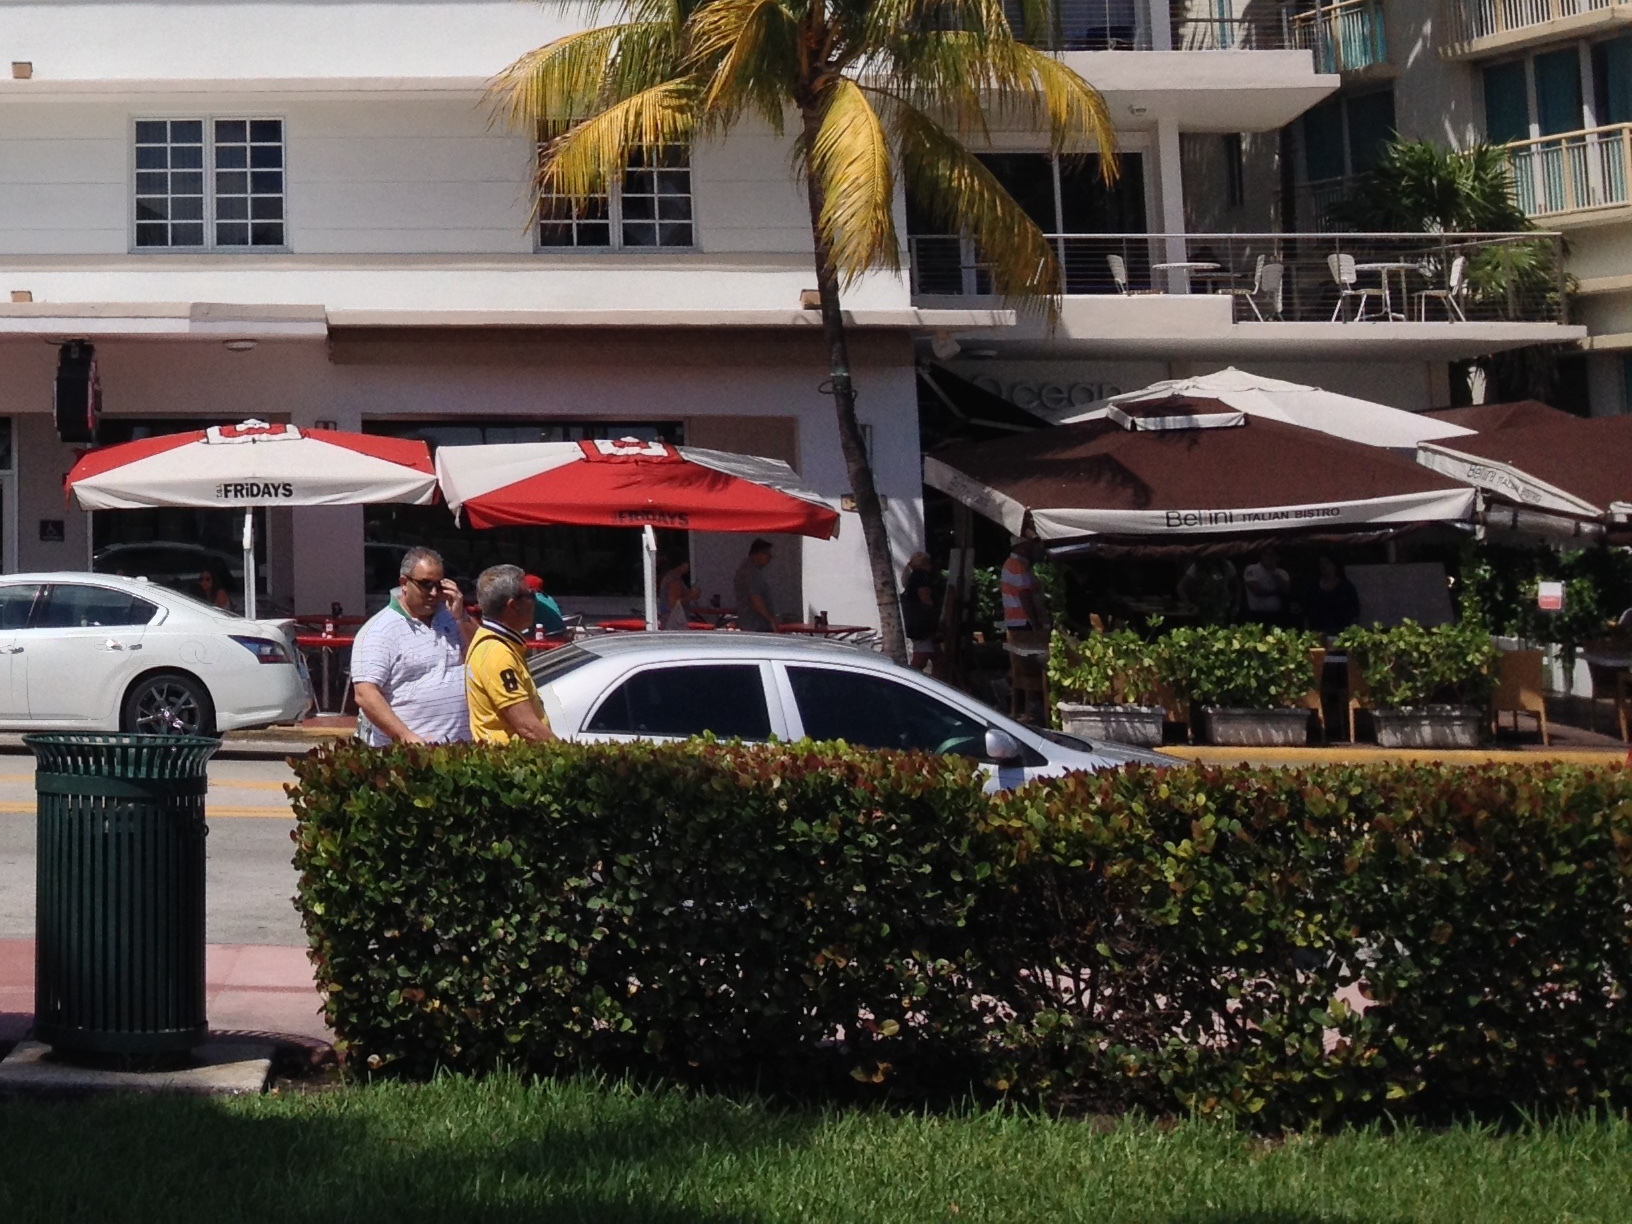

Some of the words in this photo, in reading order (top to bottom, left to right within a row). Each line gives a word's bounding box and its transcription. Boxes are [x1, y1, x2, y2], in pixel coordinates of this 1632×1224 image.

[1241, 510, 1290, 523] ITALIAN
[1294, 507, 1341, 519] BISTRO
[499, 667, 519, 694] 8
